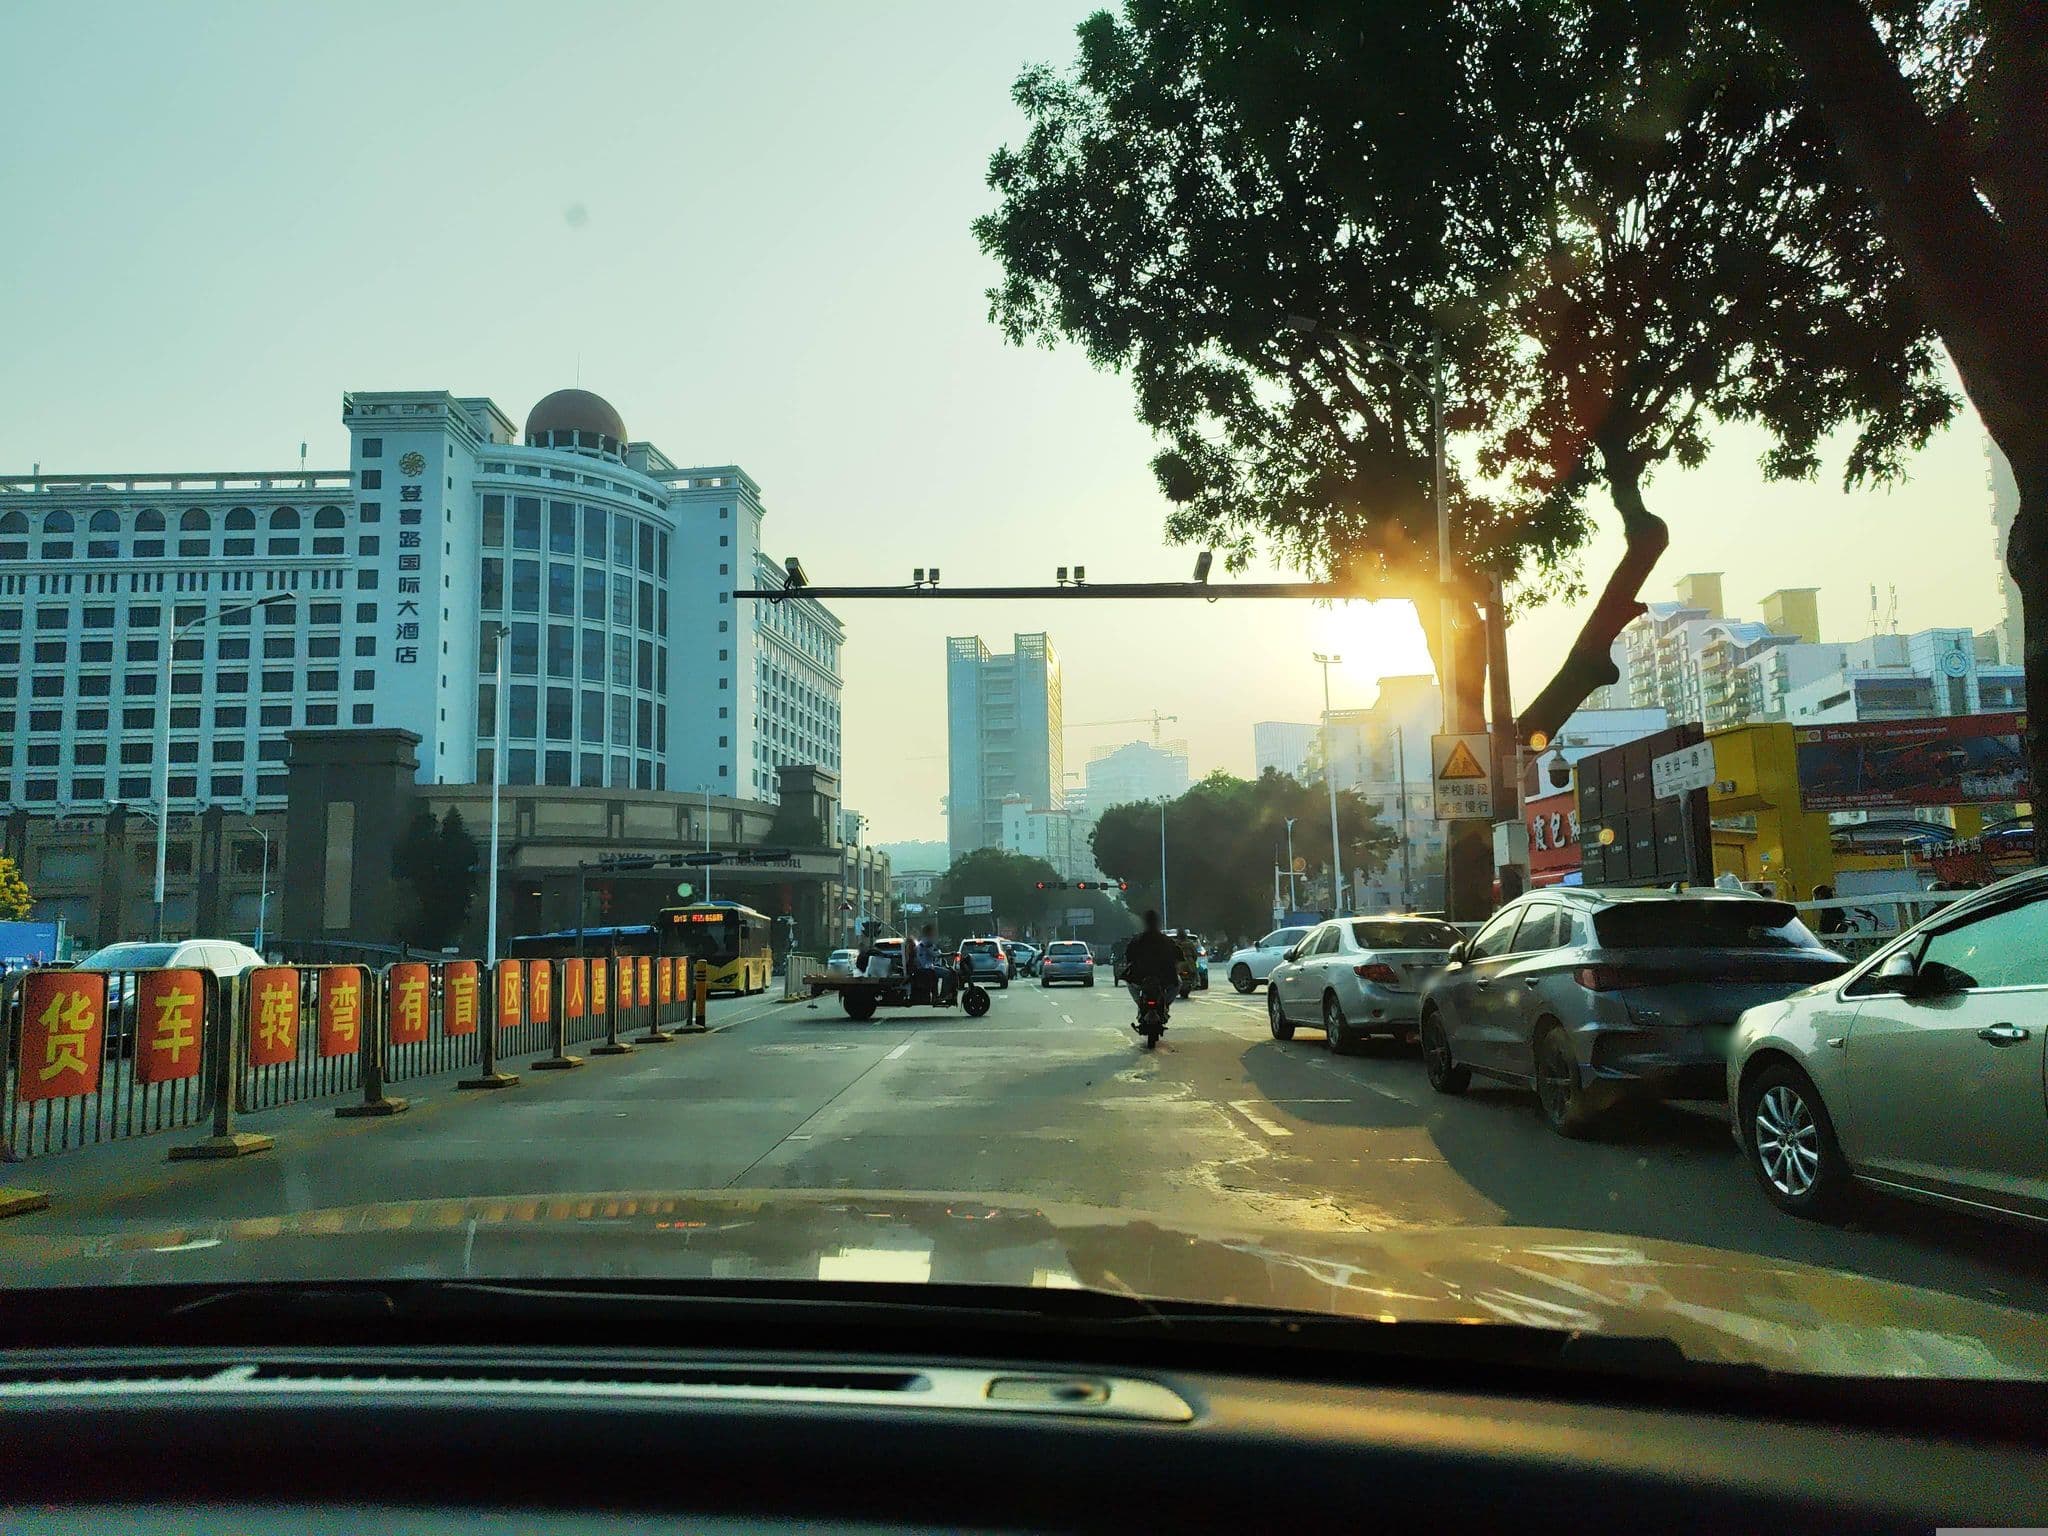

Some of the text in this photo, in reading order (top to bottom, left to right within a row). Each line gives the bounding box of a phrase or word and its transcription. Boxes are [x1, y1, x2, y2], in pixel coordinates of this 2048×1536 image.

[395, 485, 423, 664] 登喜路国际大酒店
[1439, 783, 1489, 797] 学校路段
